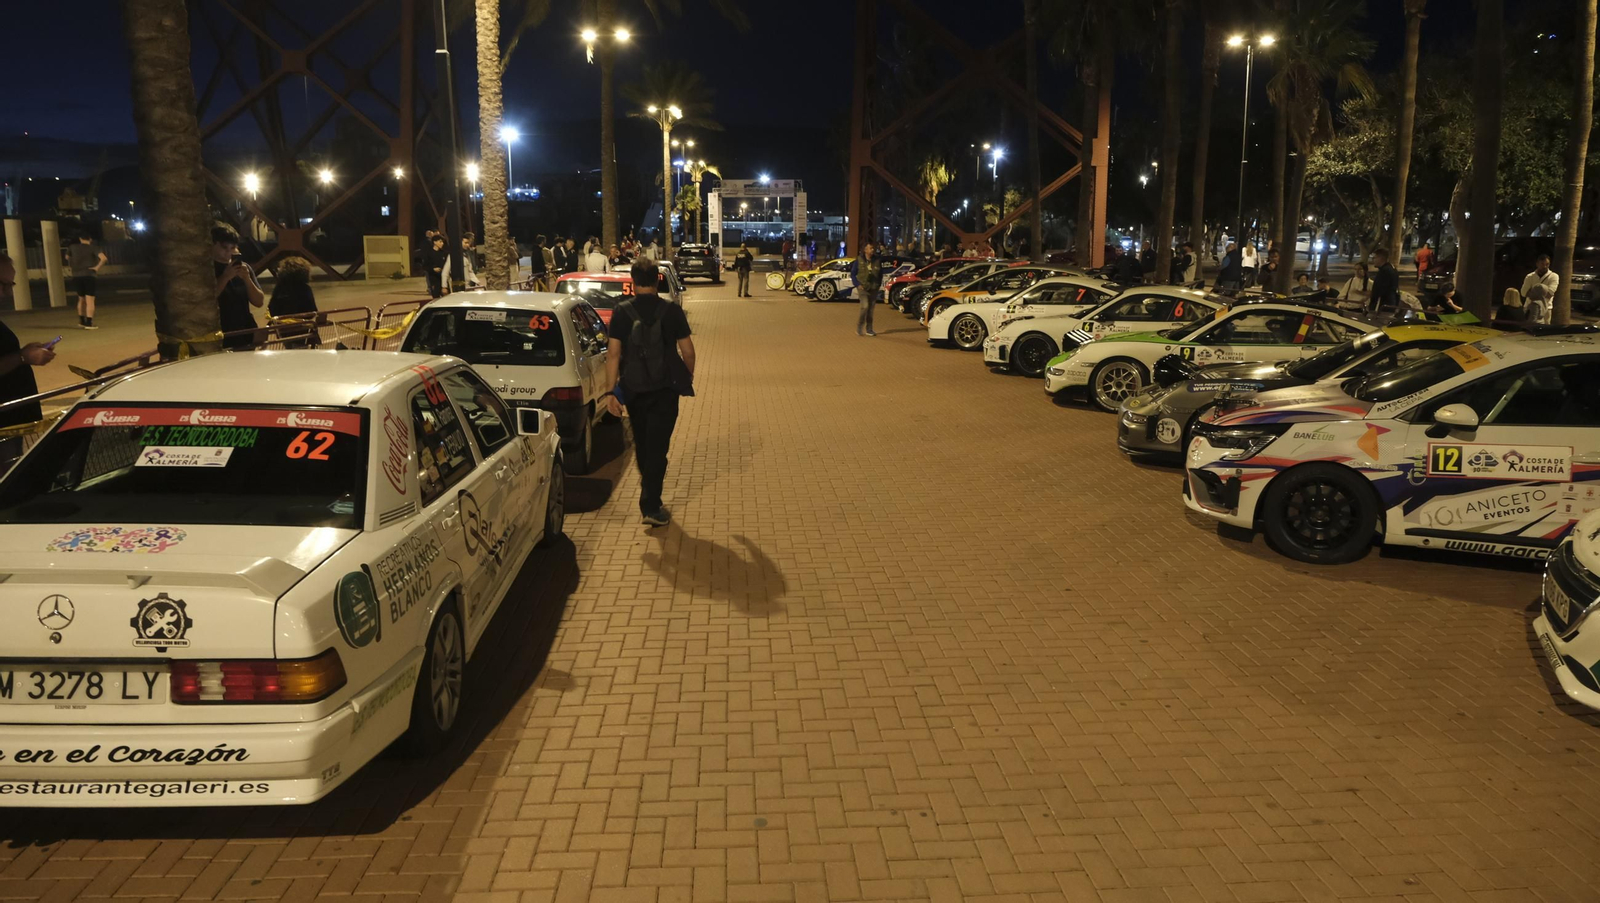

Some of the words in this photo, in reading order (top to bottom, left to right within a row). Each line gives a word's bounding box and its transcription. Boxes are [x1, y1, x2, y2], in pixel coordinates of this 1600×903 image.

[1076, 288, 1086, 301] 7
[1174, 301, 1184, 317] 6
[529, 315, 550, 330] 63
[1084, 323, 1090, 332] 6
[1183, 348, 1190, 360] 9
[510, 387, 536, 395] group
[162, 426, 258, 448] TECNOCORDOBA
[1294, 432, 1335, 441] BANELUB
[285, 430, 335, 461] 62
[1436, 448, 1459, 471] 12
[1526, 457, 1552, 465] COSTA
[1519, 464, 1564, 474] ALMERÍA
[1465, 489, 1546, 514] ANICETO
[1484, 506, 1530, 520] EVENTOS
[376, 533, 422, 577] RECREATIVOS
[383, 539, 440, 600] HERMANOS
[390, 570, 432, 624] BLANCO
[28, 672, 104, 700] 3278
[121, 672, 160, 699] LY
[14, 749, 58, 763] en
[66, 744, 101, 763] el
[107, 743, 250, 766] Corazón
